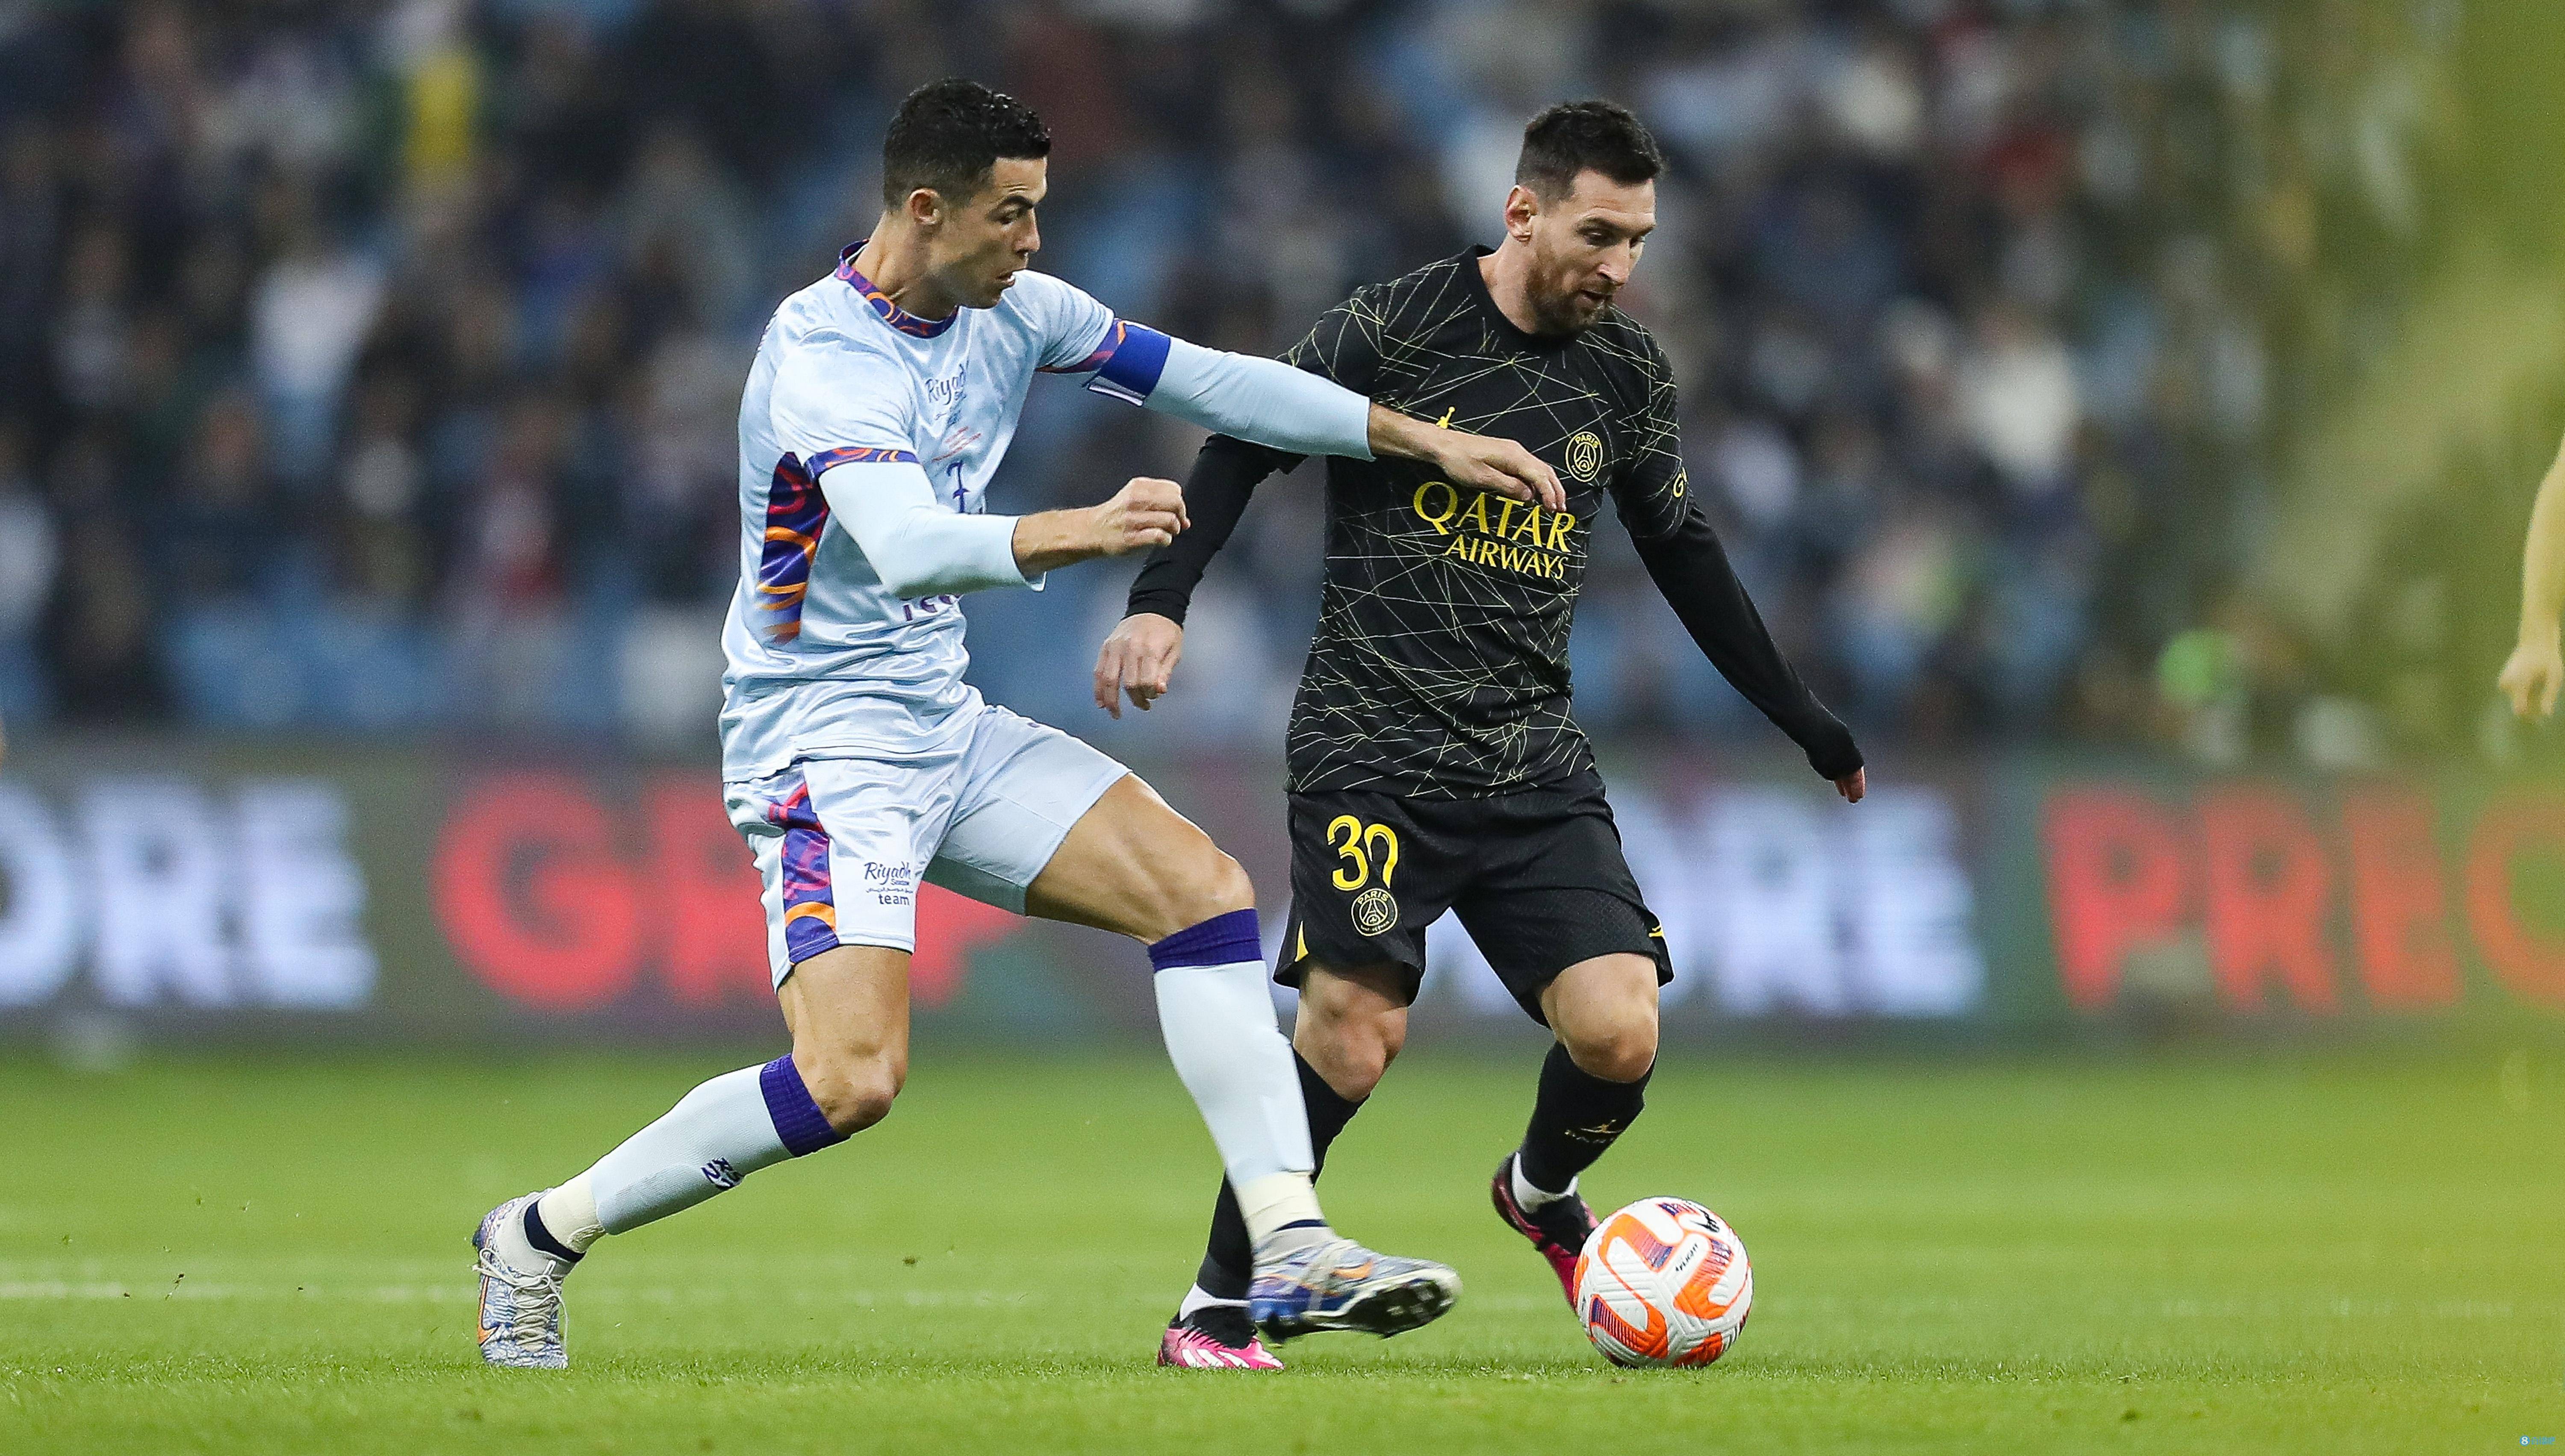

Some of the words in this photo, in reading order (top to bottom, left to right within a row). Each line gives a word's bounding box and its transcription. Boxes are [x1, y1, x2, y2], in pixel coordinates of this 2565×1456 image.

[1574, 434, 1600, 449] PARIS
[1412, 481, 1576, 553] QATAR
[1444, 534, 1569, 580] AIRWAYS
[1327, 814, 1398, 891] 30
[878, 894, 910, 906] team
[1357, 890, 1389, 905] PARIS
